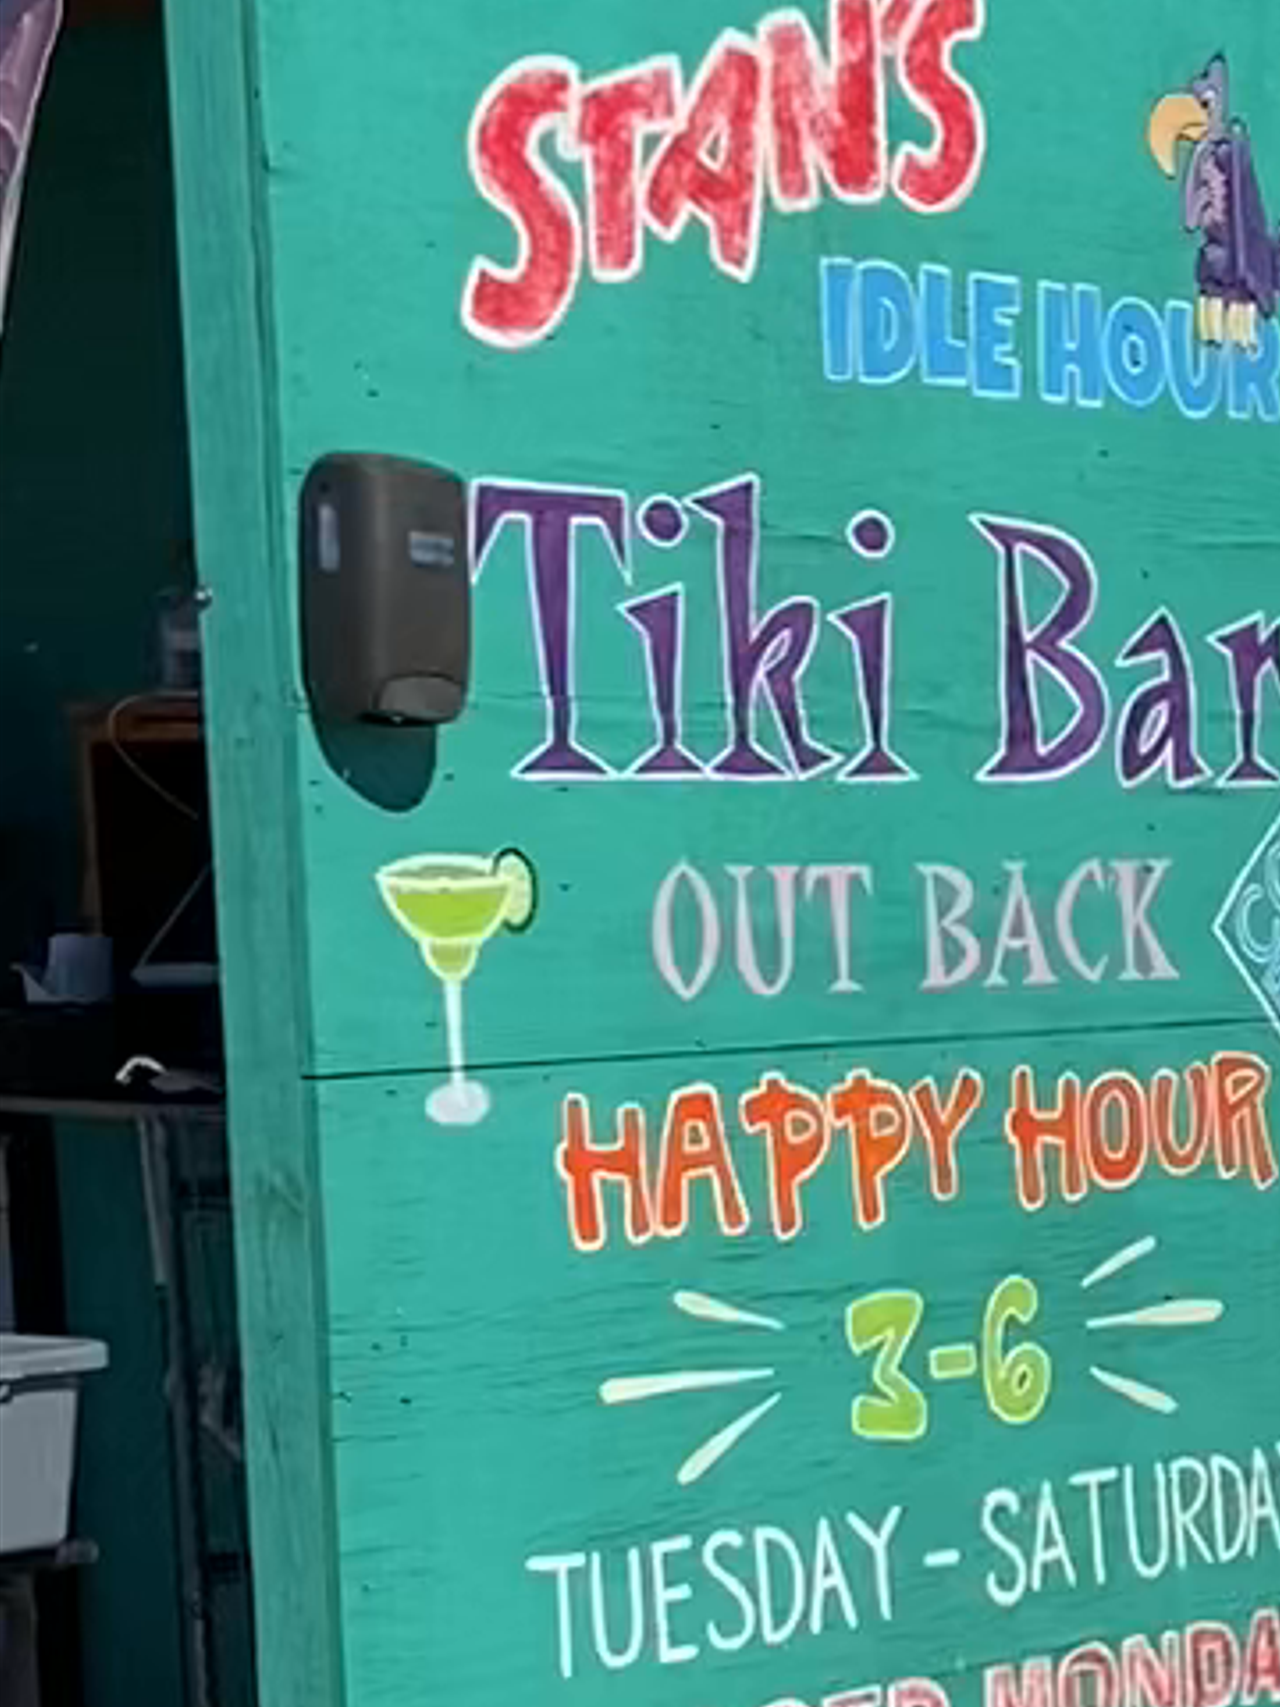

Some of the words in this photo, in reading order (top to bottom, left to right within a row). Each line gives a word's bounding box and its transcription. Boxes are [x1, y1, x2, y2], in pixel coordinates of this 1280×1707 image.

[818, 255, 1022, 400] IDLE
[470, 472, 920, 783] Tiki
[650, 856, 873, 1003] OUT
[913, 853, 1182, 994] BACK
[555, 1068, 982, 1250] HAPPY
[1004, 1049, 1279, 1211] HOUR
[844, 1273, 1052, 1442] 3-6
[525, 1504, 904, 1679] TUESDAY
